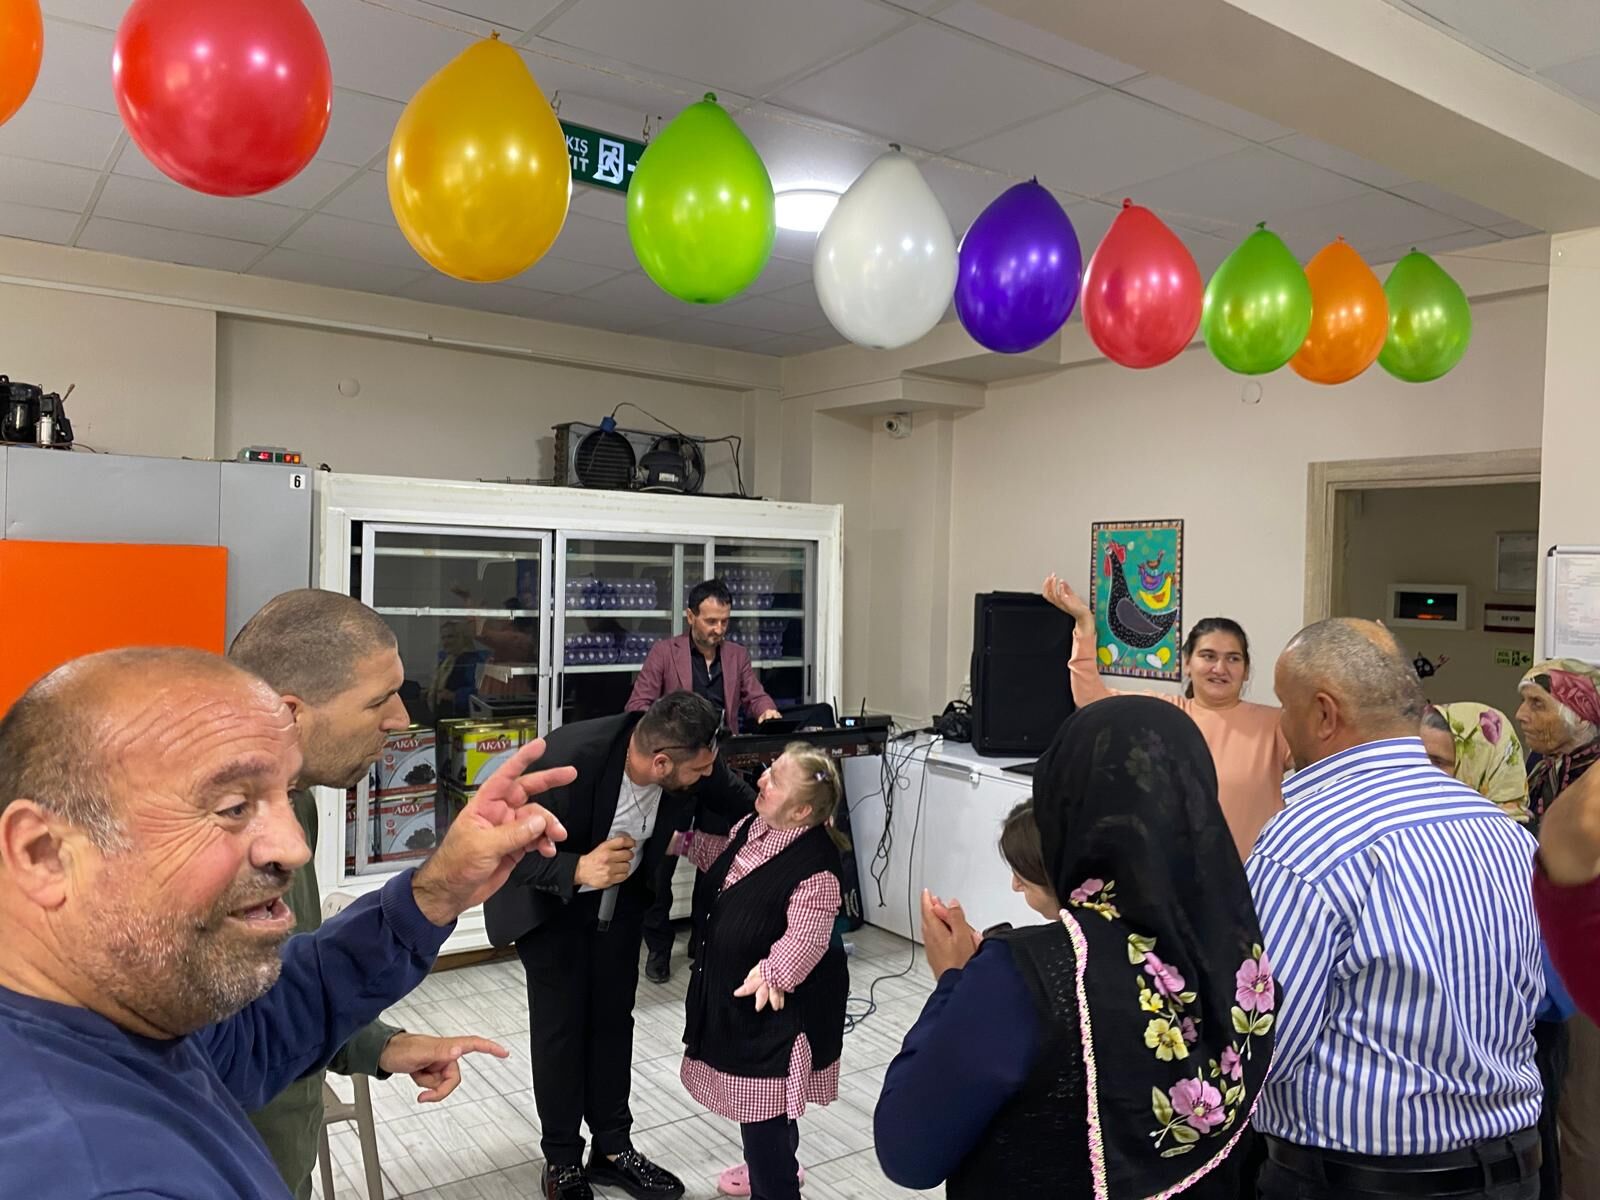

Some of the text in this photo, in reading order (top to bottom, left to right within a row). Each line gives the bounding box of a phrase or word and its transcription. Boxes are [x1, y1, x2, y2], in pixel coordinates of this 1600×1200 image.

[569, 155, 589, 172] IT
[294, 475, 301, 488] 6
[393, 739, 420, 750] AKAY
[478, 740, 507, 752] AKAY
[394, 804, 421, 815] AKAY
